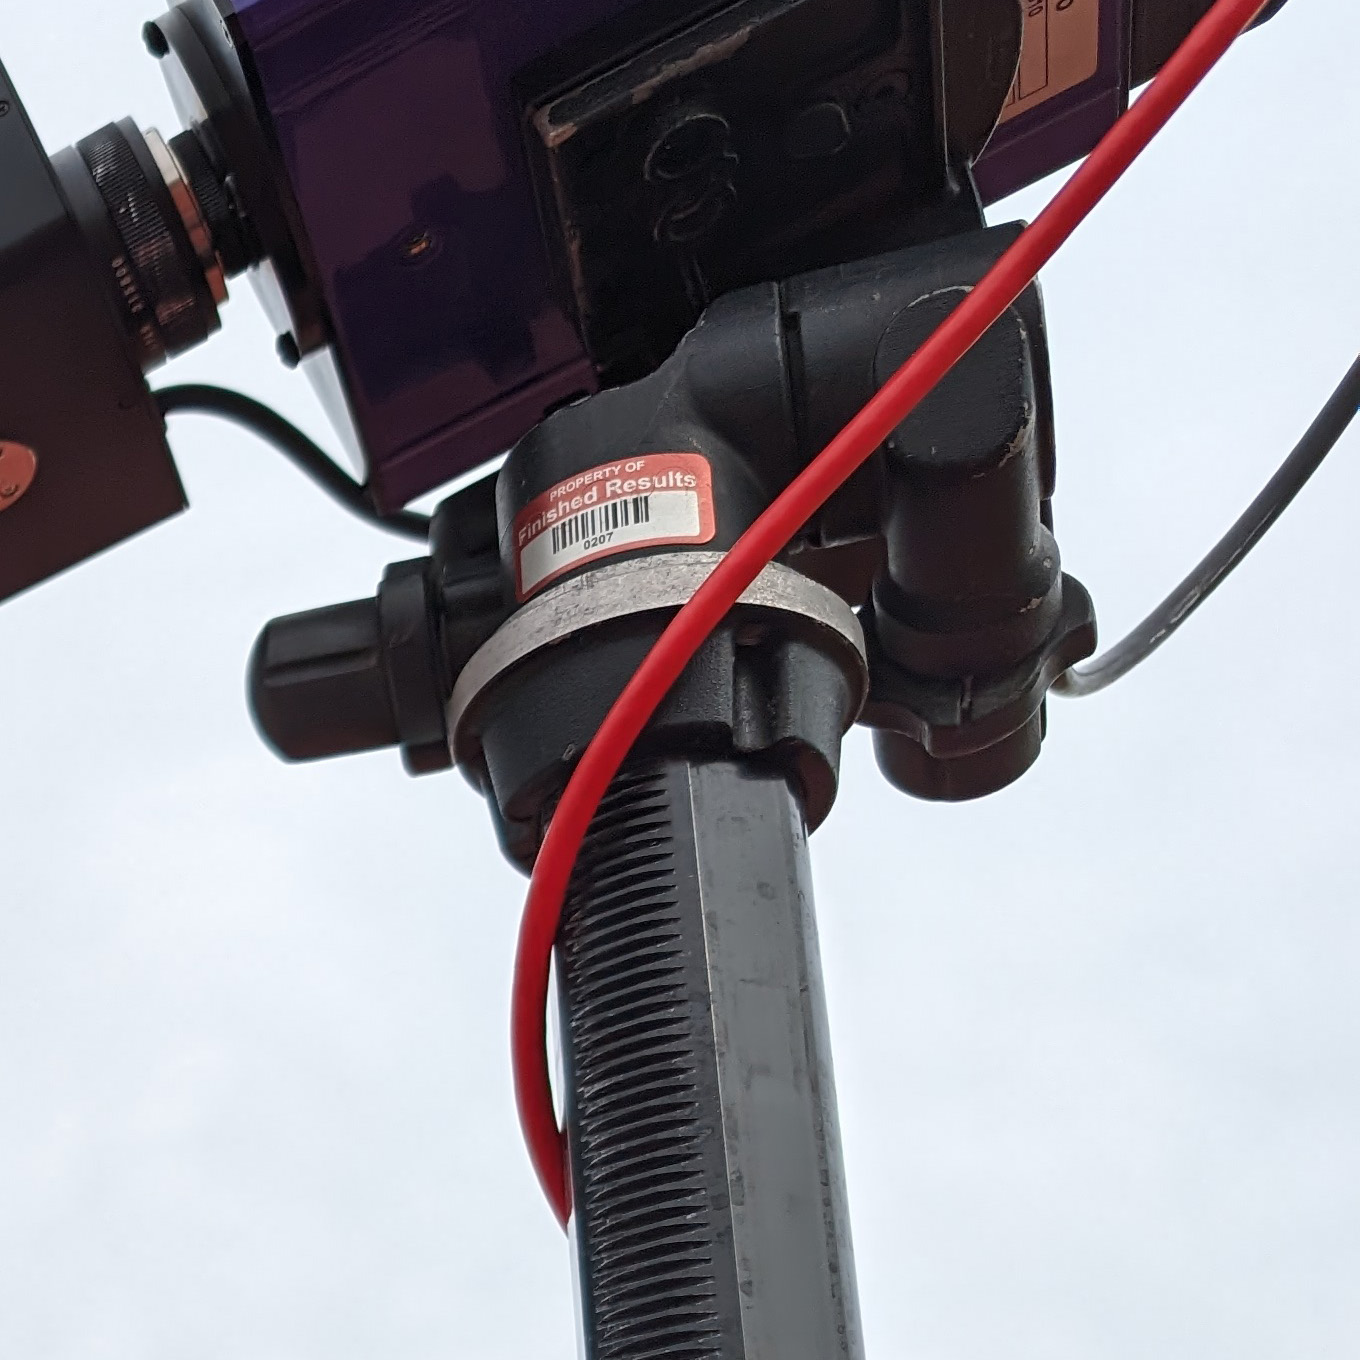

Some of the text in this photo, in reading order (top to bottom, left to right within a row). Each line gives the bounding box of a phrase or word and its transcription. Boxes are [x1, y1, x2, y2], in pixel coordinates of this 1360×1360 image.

[549, 460, 645, 502] PROPERTY OF
[518, 470, 697, 547] Finished Results
[583, 532, 614, 551] 0207
